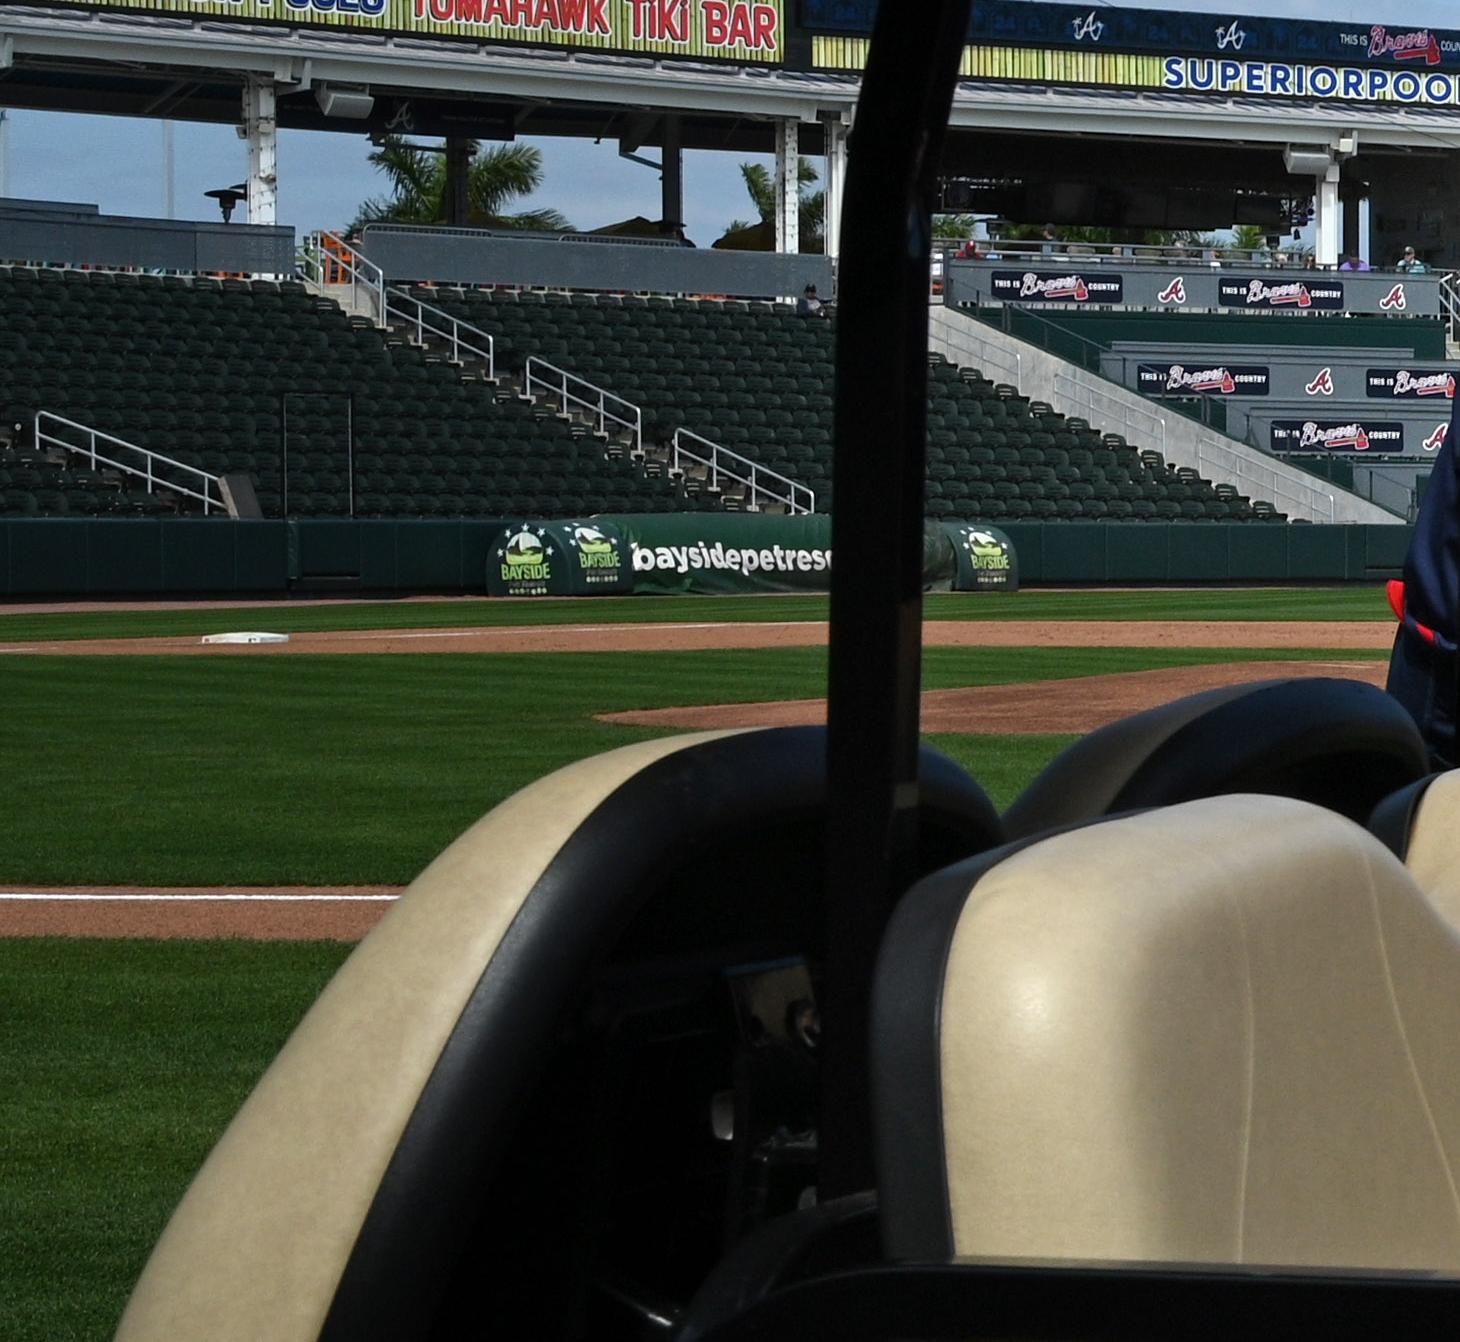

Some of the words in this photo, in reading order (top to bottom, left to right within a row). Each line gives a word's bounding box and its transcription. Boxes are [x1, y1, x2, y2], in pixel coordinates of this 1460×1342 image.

[702, 0, 778, 52] BAR
[1340, 34, 1358, 46] THIS
[1360, 35, 1368, 46] IS
[994, 279, 1012, 288] THIS
[1012, 280, 1021, 288] IS
[1020, 273, 1079, 297] Braves
[1088, 282, 1120, 291] COUNTRY
[1222, 286, 1238, 295] THIS
[1239, 287, 1247, 295] IS
[1246, 279, 1302, 304] Braves
[1311, 290, 1341, 299] COUNTRY
[1235, 375, 1266, 383] COUNTRY
[1369, 377, 1386, 386] THIS
[1387, 378, 1394, 386] IS
[1393, 370, 1449, 395] Braves
[1300, 421, 1359, 447] Braves
[1368, 431, 1400, 440] COUNTRY
[578, 551, 621, 568] BAYSIDE
[970, 554, 1010, 569] BAYSIDE
[501, 562, 551, 580] BAYSIDE
